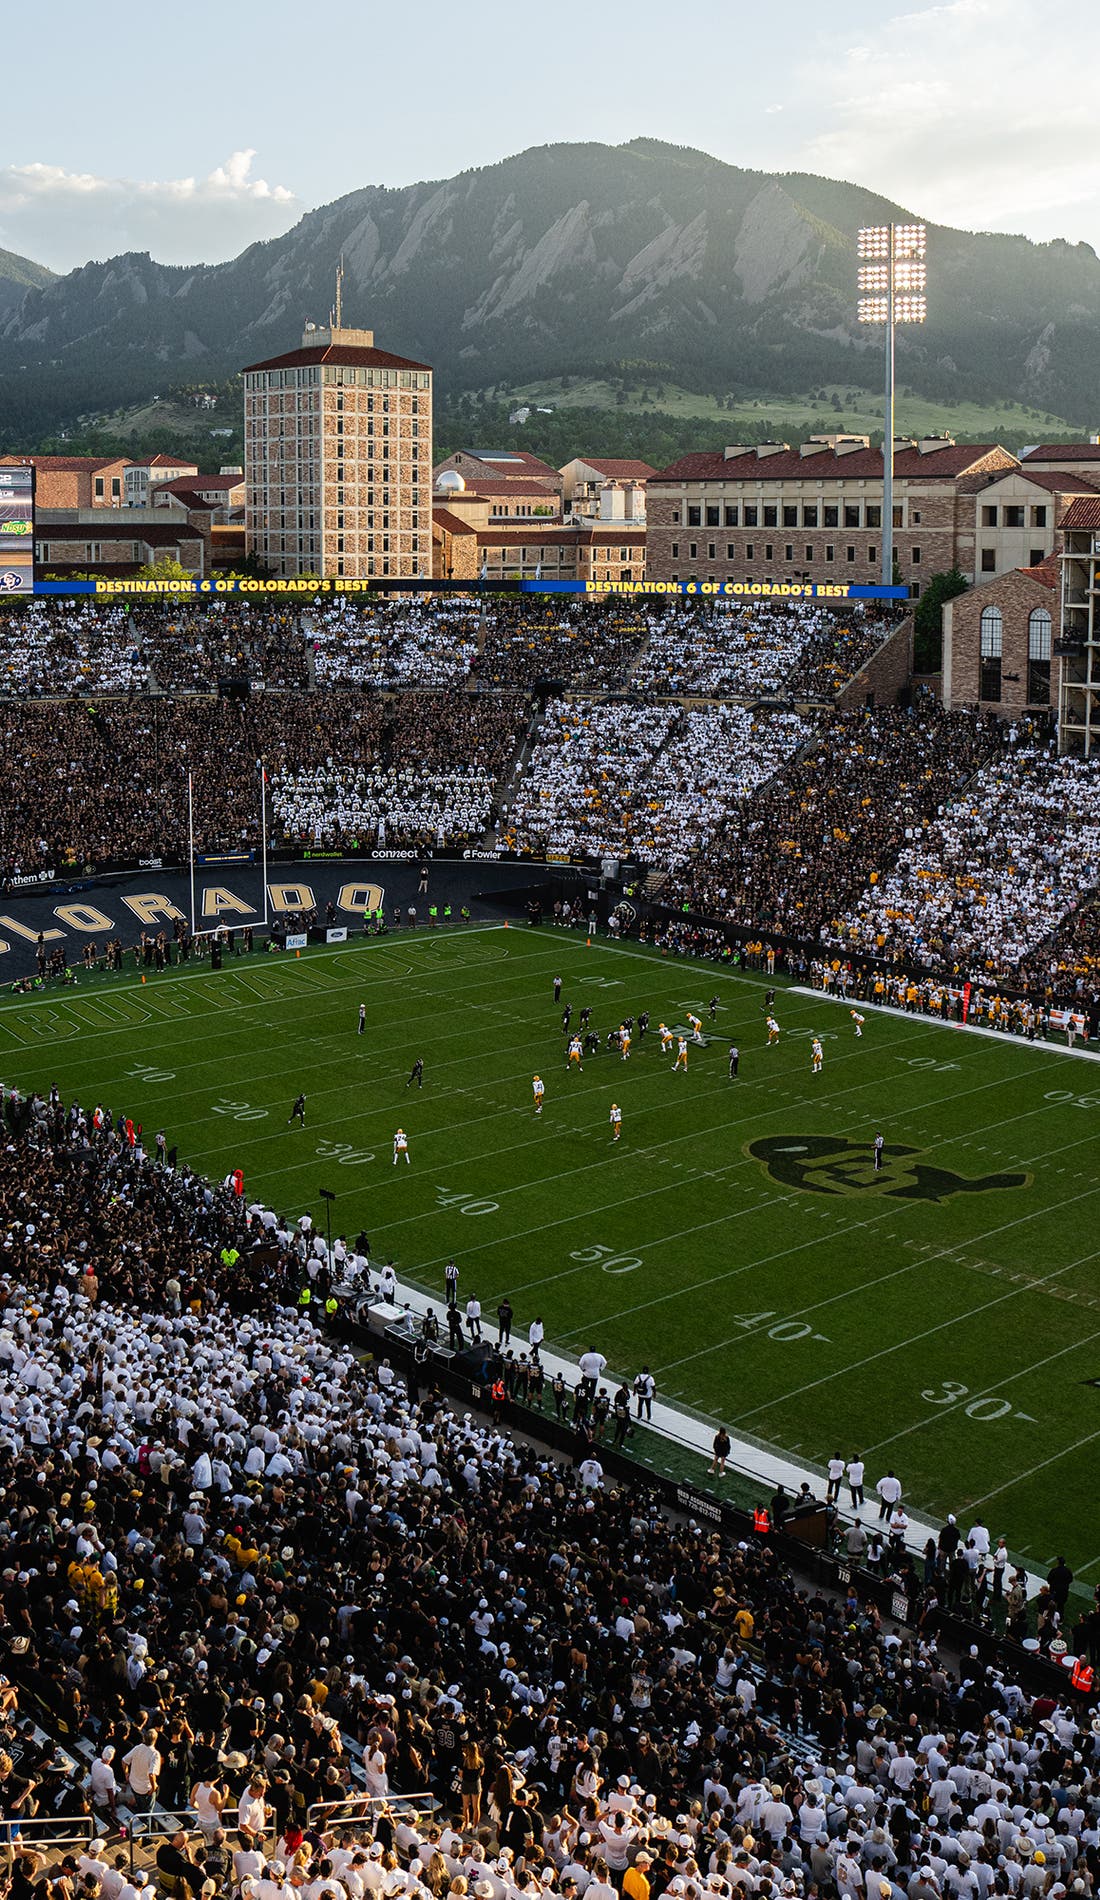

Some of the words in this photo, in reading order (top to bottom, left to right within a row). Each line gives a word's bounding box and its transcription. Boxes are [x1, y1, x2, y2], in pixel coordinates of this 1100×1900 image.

[2, 524, 25, 532] NDSU
[96, 581, 197, 592] DESTINATION:
[201, 581, 211, 592] 6
[215, 581, 235, 592] OF
[239, 580, 331, 592] COLORADO'S
[335, 580, 369, 591] BEST
[586, 581, 683, 594] DESTINATION:
[687, 582, 697, 594] 6
[701, 582, 721, 595] OF
[724, 583, 813, 597] COLORADO'S
[817, 585, 850, 597] BEST
[471, 849, 502, 860] Fowler
[123, 1066, 176, 1083] 10
[211, 1101, 270, 1121] 20
[315, 1143, 376, 1165] 30
[434, 1193, 499, 1216] 40
[569, 1244, 643, 1273] 50
[733, 1311, 812, 1341] 40
[920, 1381, 1013, 1421] 30
[551, 1516, 557, 1527] 2
[838, 1569, 851, 1584] 119
[344, 1578, 355, 1592] 13
[754, 1793, 761, 1806] 2
[704, 1844, 712, 1854] 2
